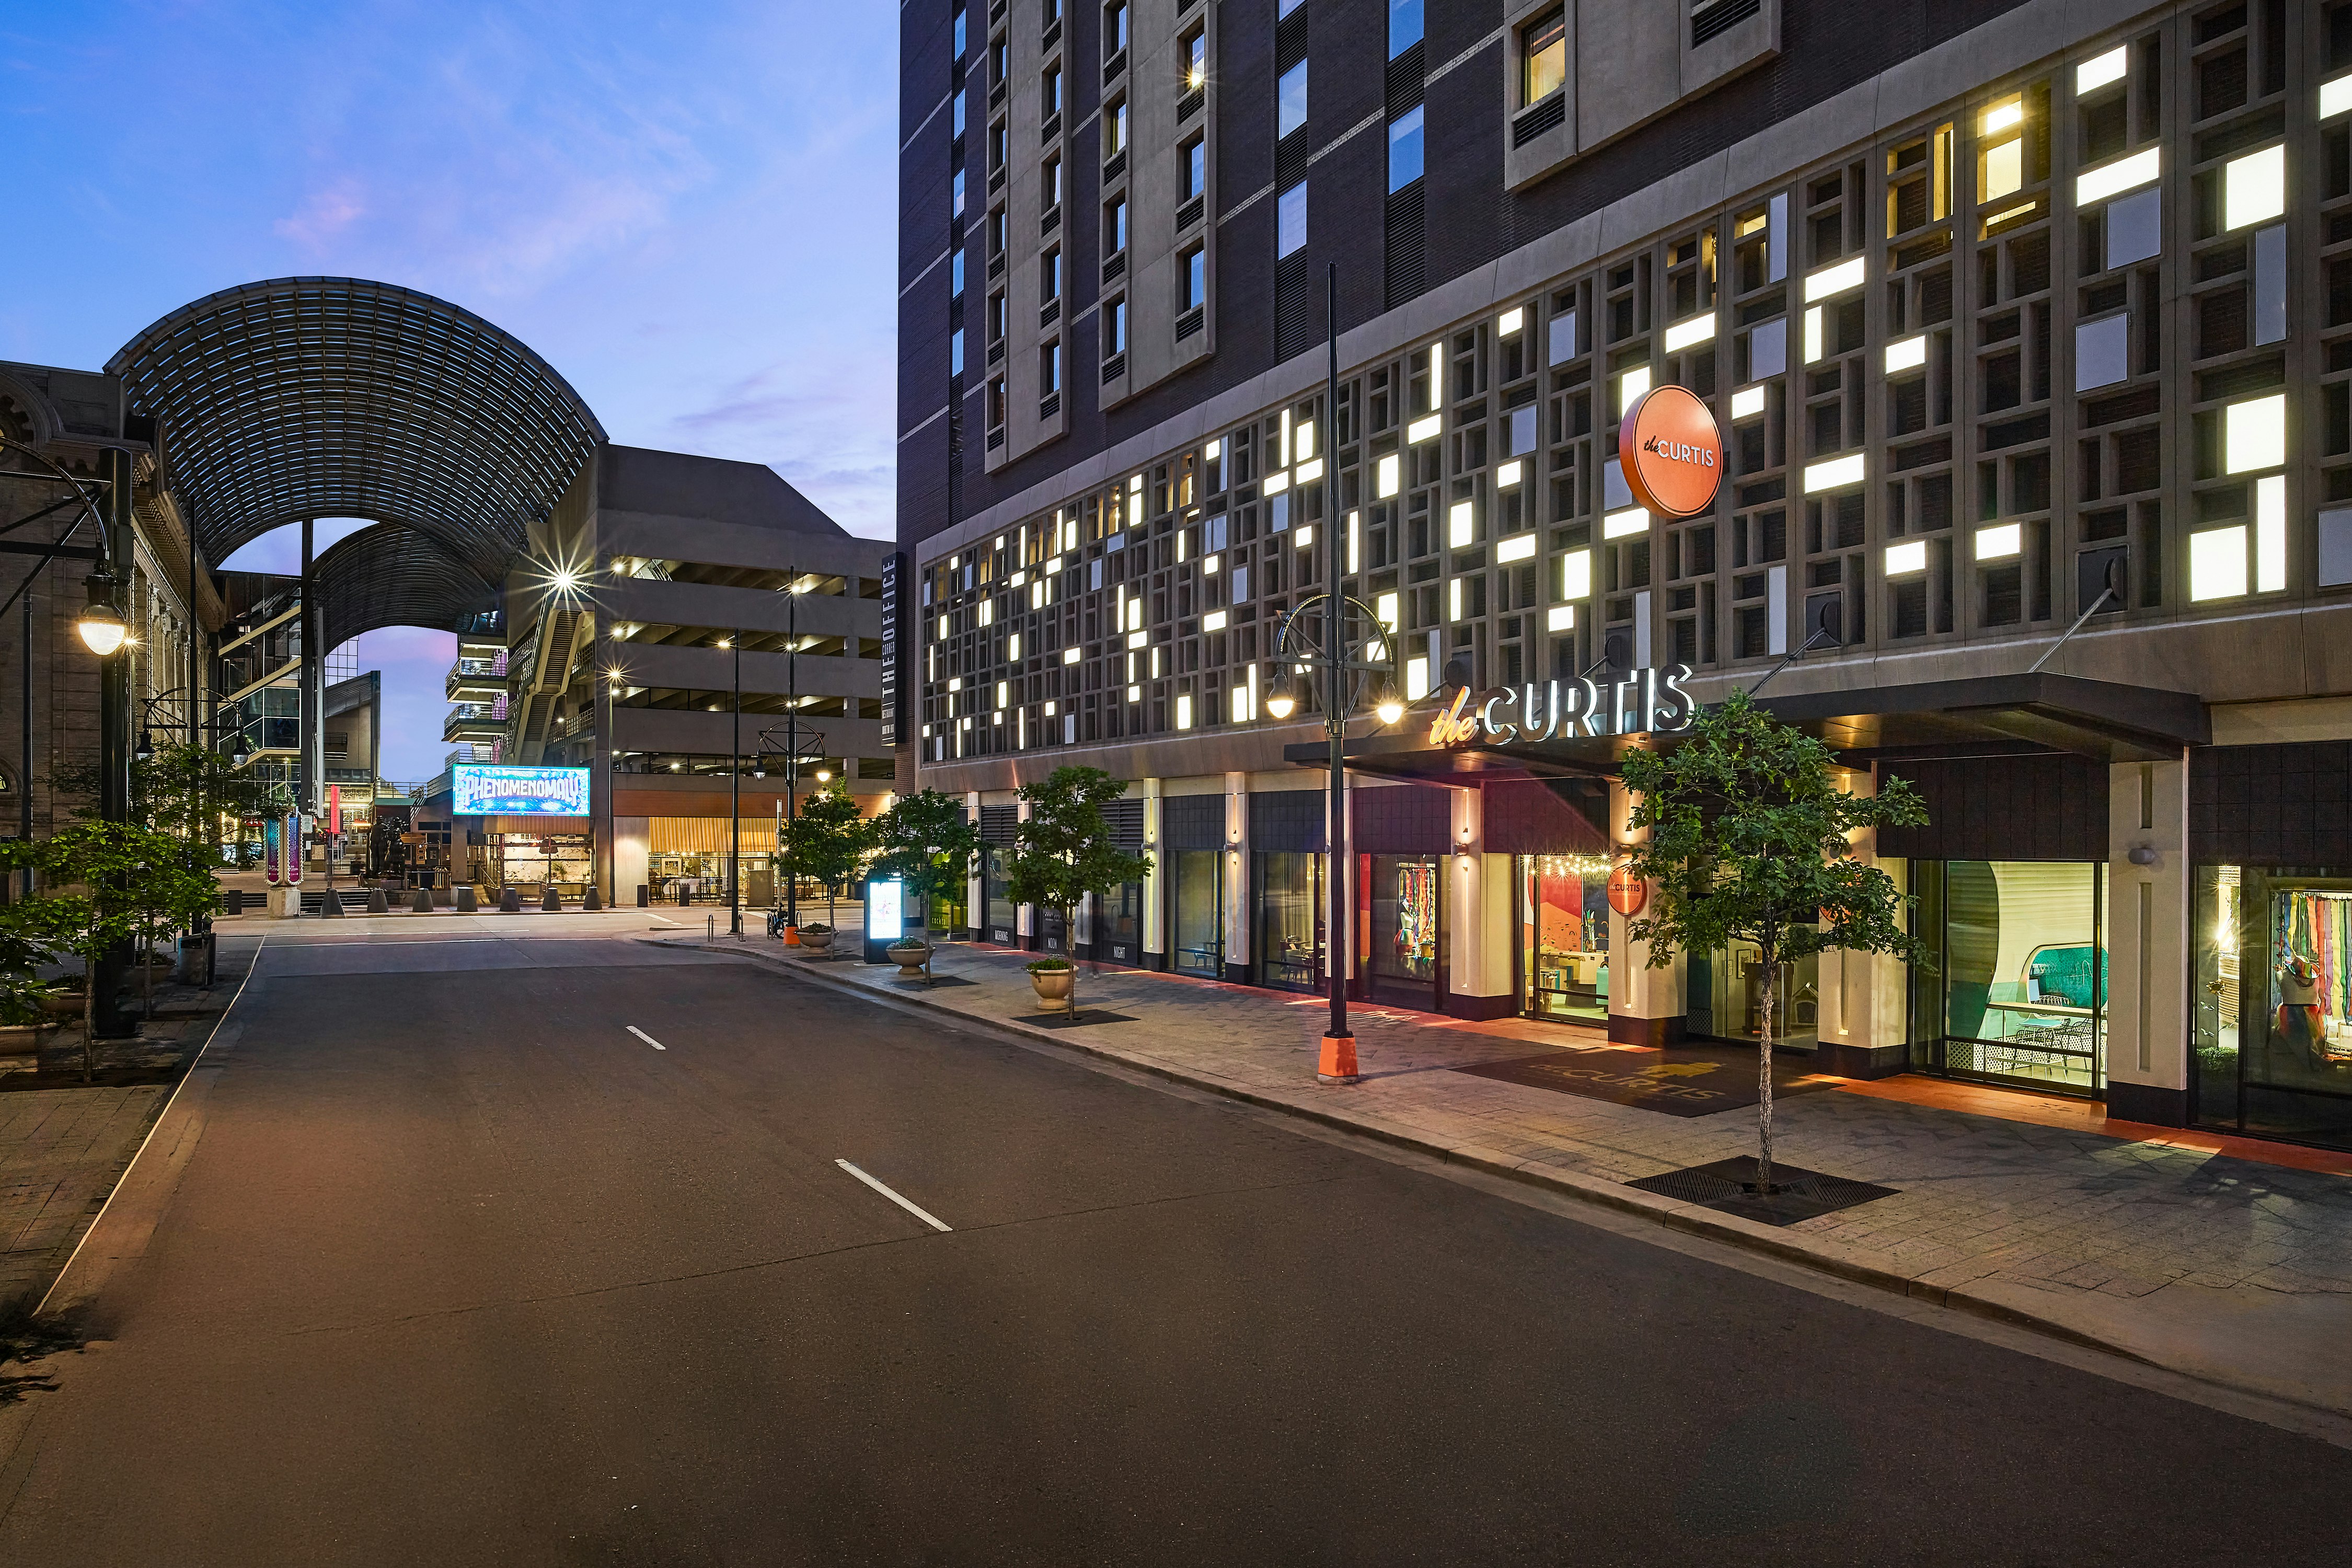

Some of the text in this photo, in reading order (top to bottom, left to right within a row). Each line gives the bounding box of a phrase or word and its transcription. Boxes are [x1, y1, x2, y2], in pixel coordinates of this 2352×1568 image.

[1644, 435, 1714, 467] the CURTIS
[882, 560, 895, 698] THE CORNER OFFICE
[1429, 663, 1695, 745] the CURTIS
[465, 775, 579, 806] PHENOMENOMALY
[995, 930, 1008, 941] MORNING
[1048, 938, 1057, 949] NOON
[1114, 946, 1125, 959] NIGHT
[1563, 1069, 1726, 1099] CURTIS
